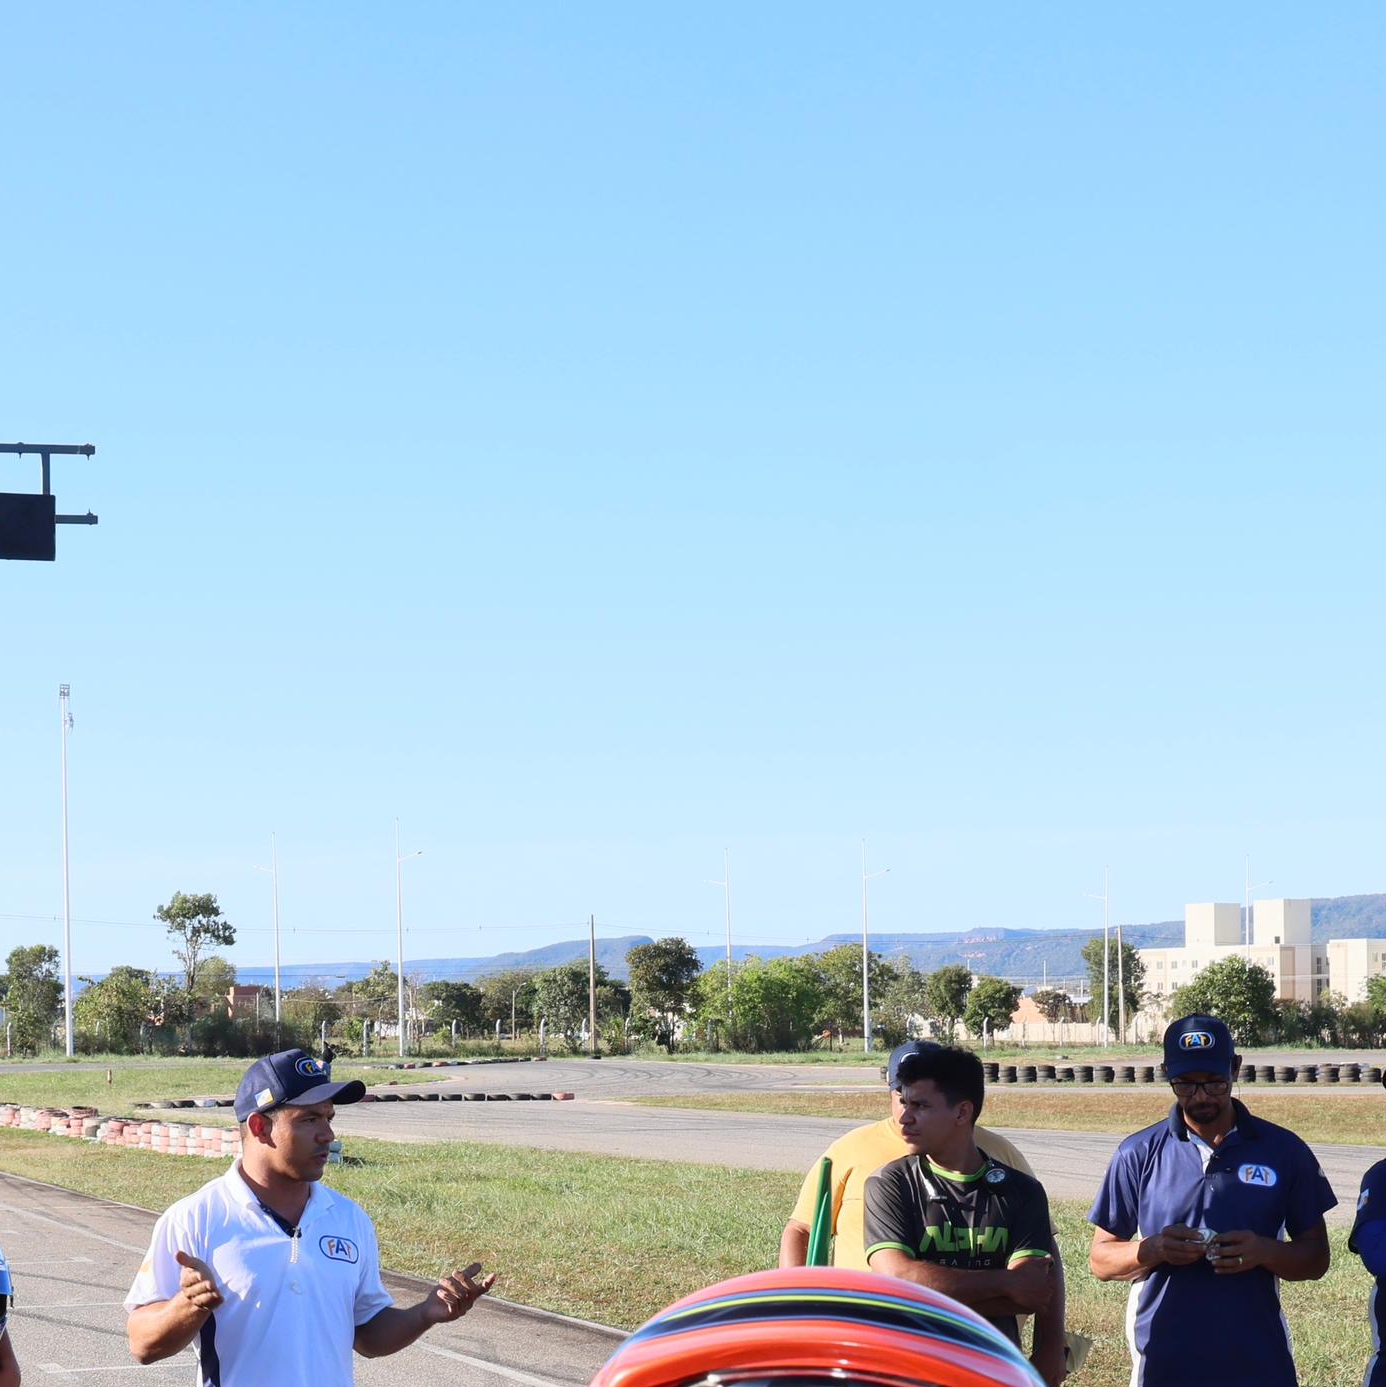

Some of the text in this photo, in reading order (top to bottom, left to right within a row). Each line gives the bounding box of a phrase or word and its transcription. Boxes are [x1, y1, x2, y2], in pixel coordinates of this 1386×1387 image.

[1184, 1034, 1207, 1048] FAT
[1245, 1167, 1270, 1185] FAT
[327, 1238, 352, 1259] FAT
[939, 1259, 991, 1267] RAING
